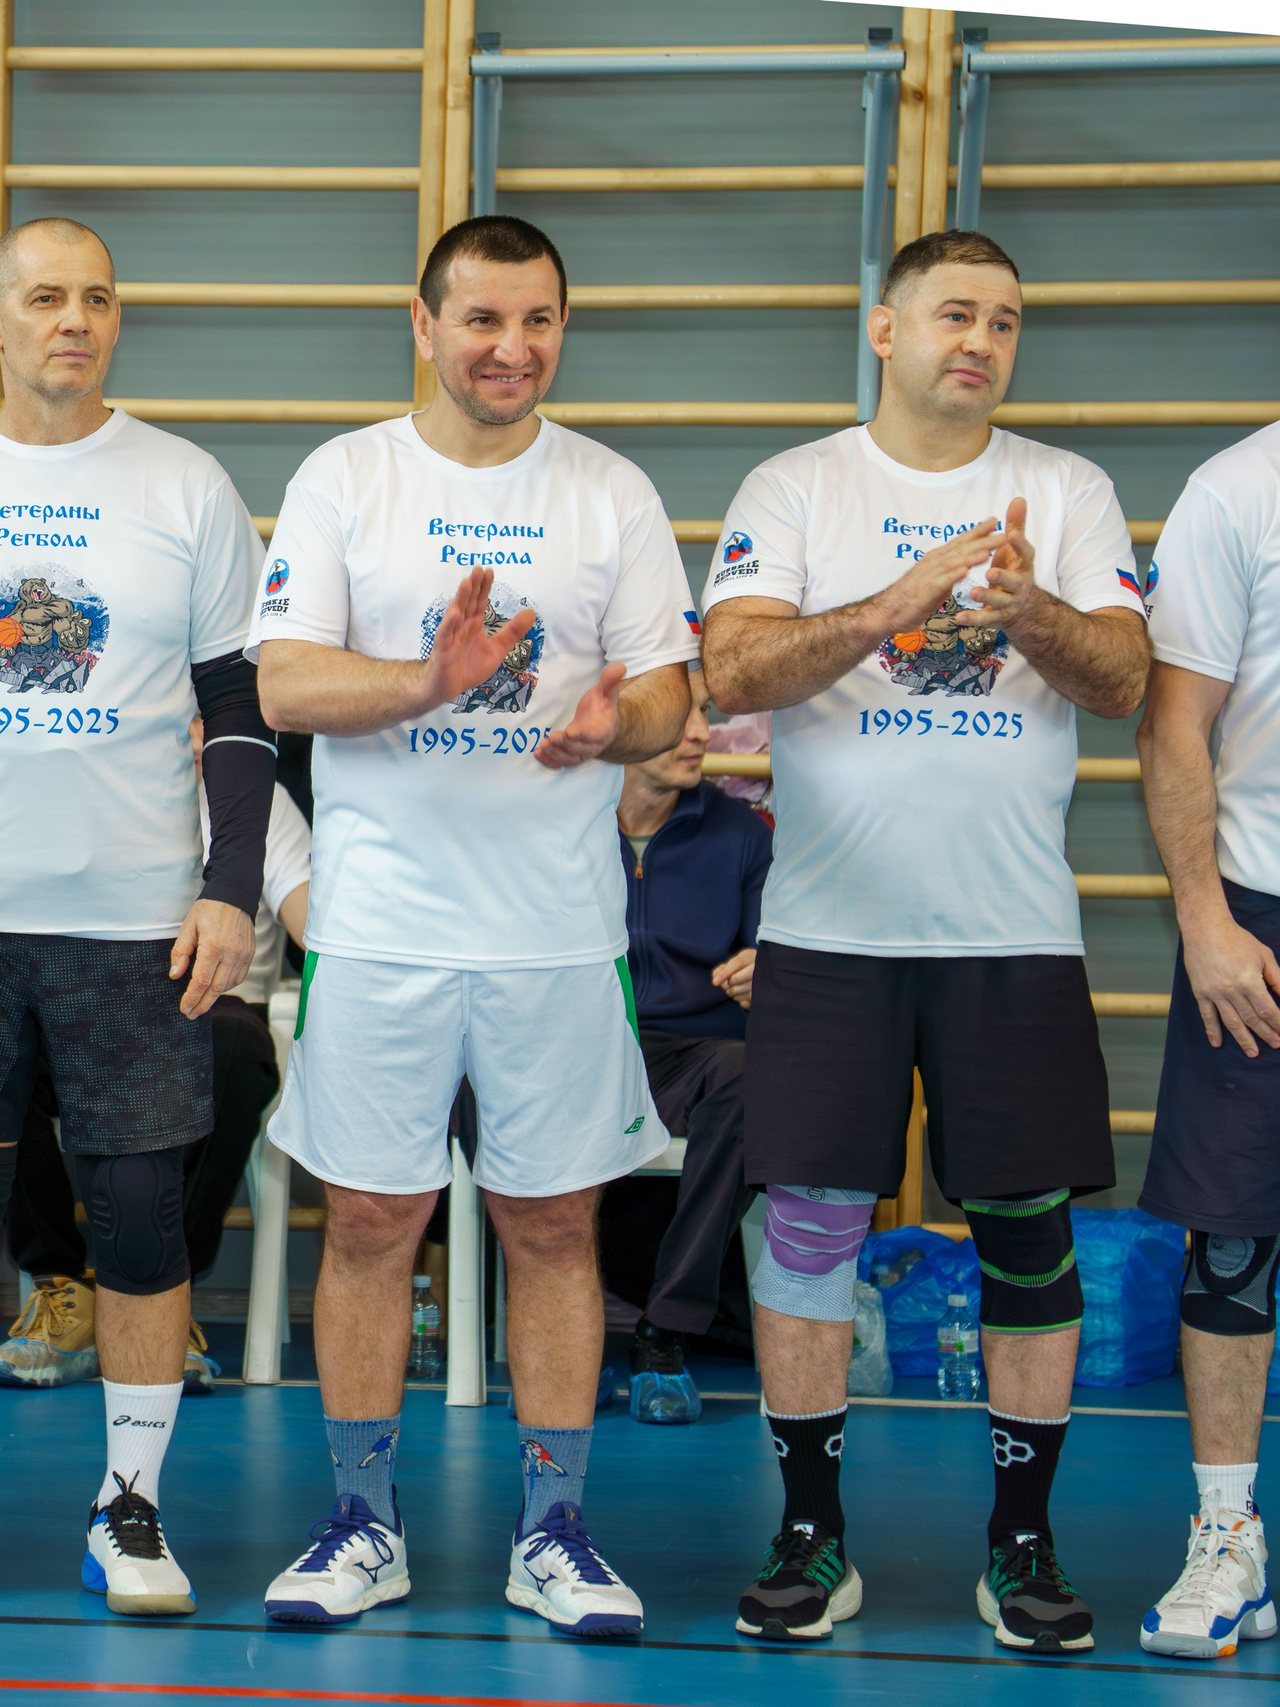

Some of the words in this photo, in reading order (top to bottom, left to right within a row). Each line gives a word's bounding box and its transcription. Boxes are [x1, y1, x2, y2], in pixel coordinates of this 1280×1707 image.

[427, 518, 544, 542] Ветераны
[439, 544, 533, 566] Регбола
[858, 708, 1023, 739] 1995-2025
